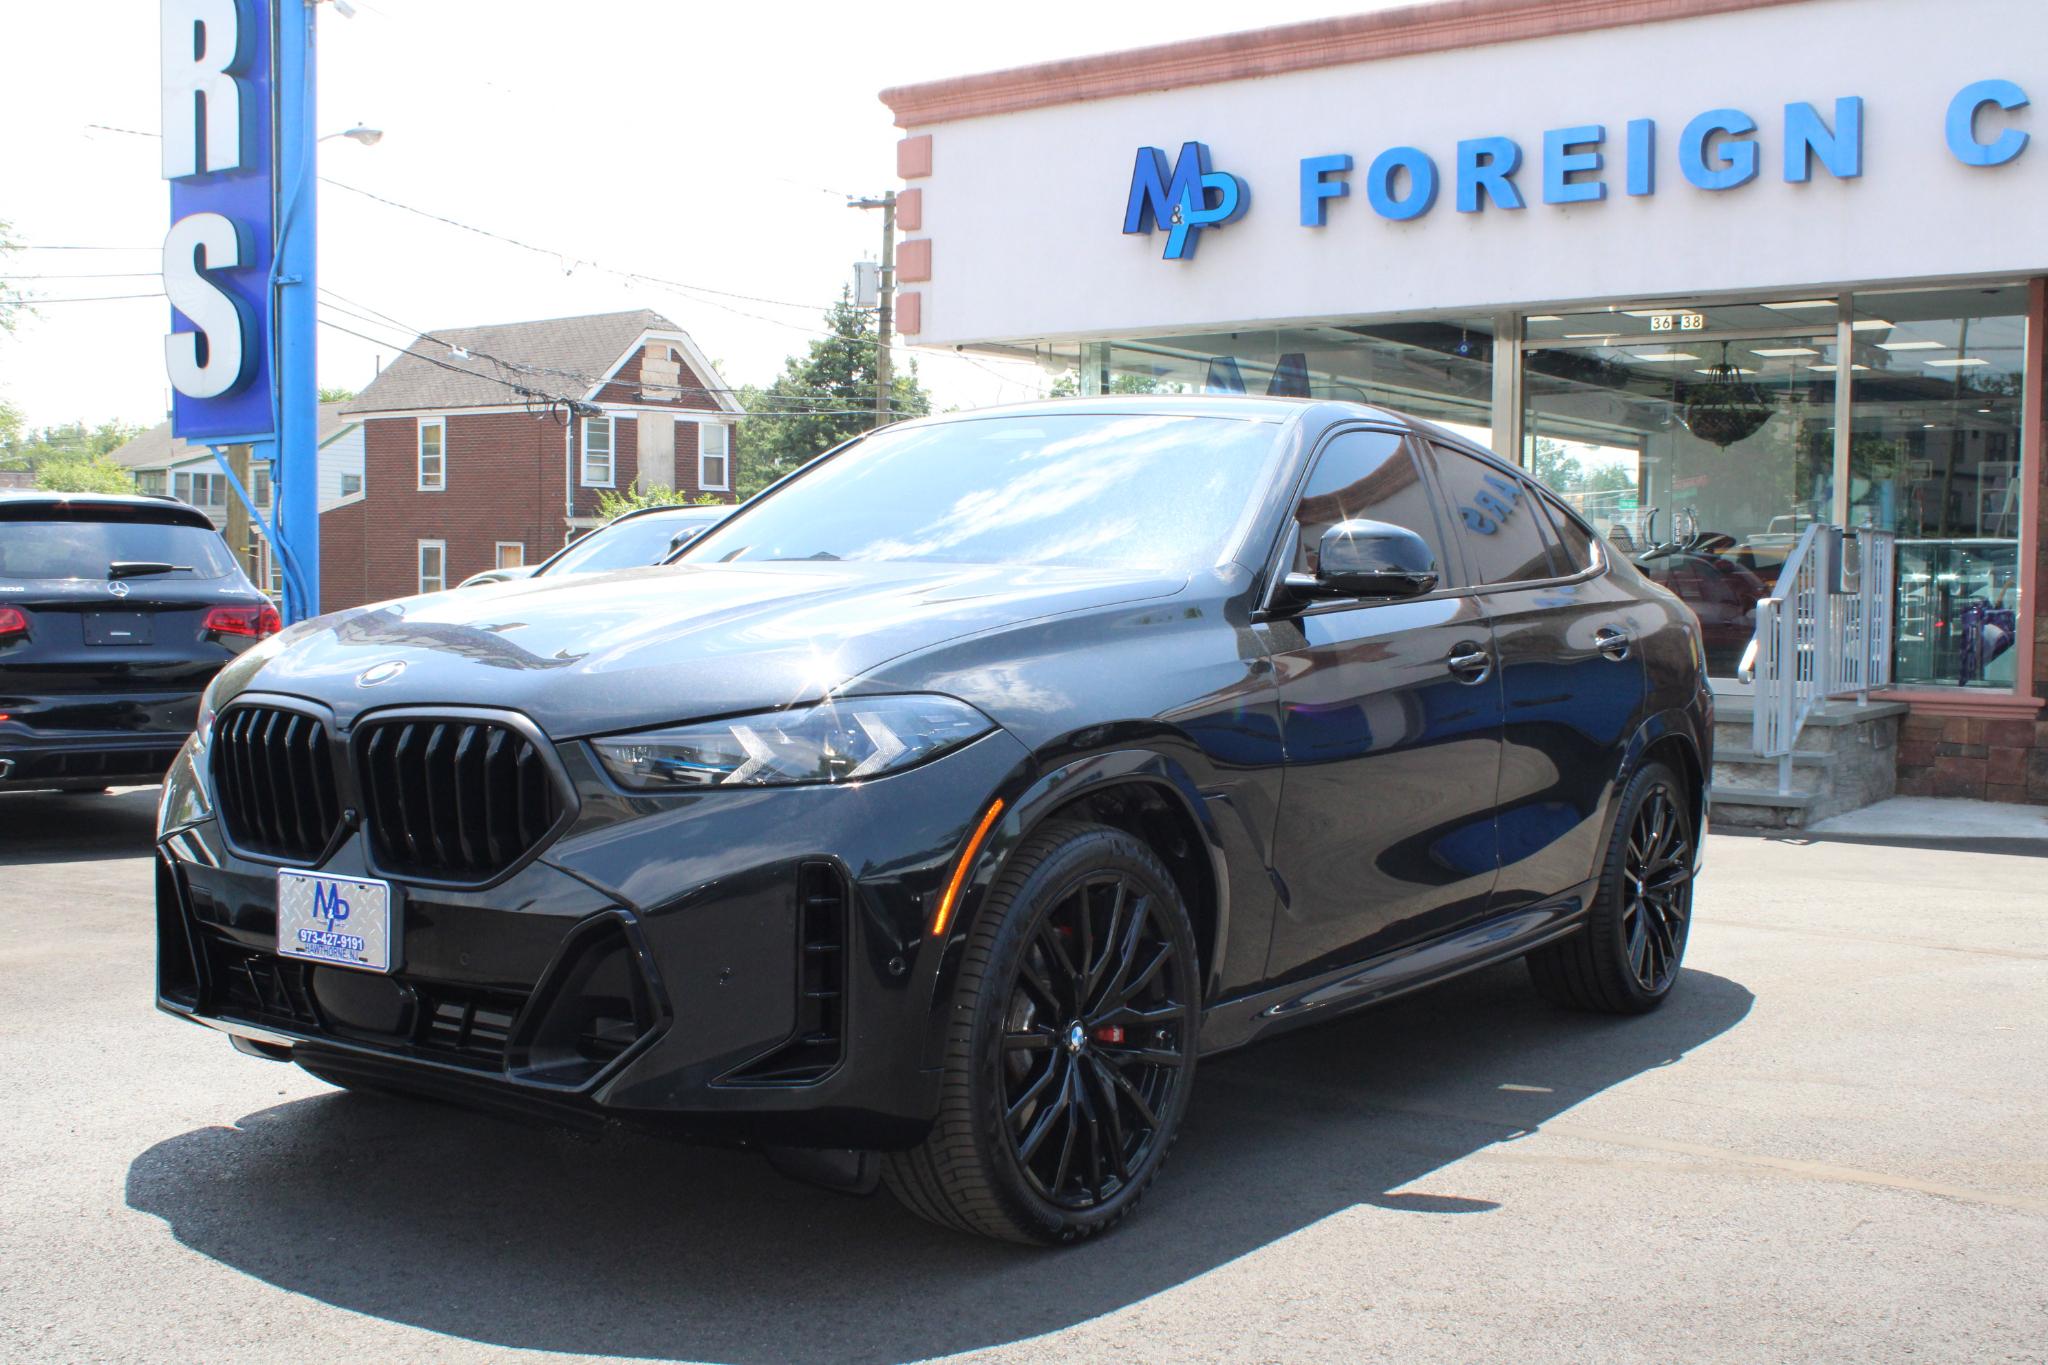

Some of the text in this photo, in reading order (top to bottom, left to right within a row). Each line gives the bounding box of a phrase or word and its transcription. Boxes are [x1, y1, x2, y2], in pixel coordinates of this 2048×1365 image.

[1300, 96, 1864, 226] FOREIGN
[1945, 79, 2030, 167] C
[300, 930, 363, 950] 973-427-9191
